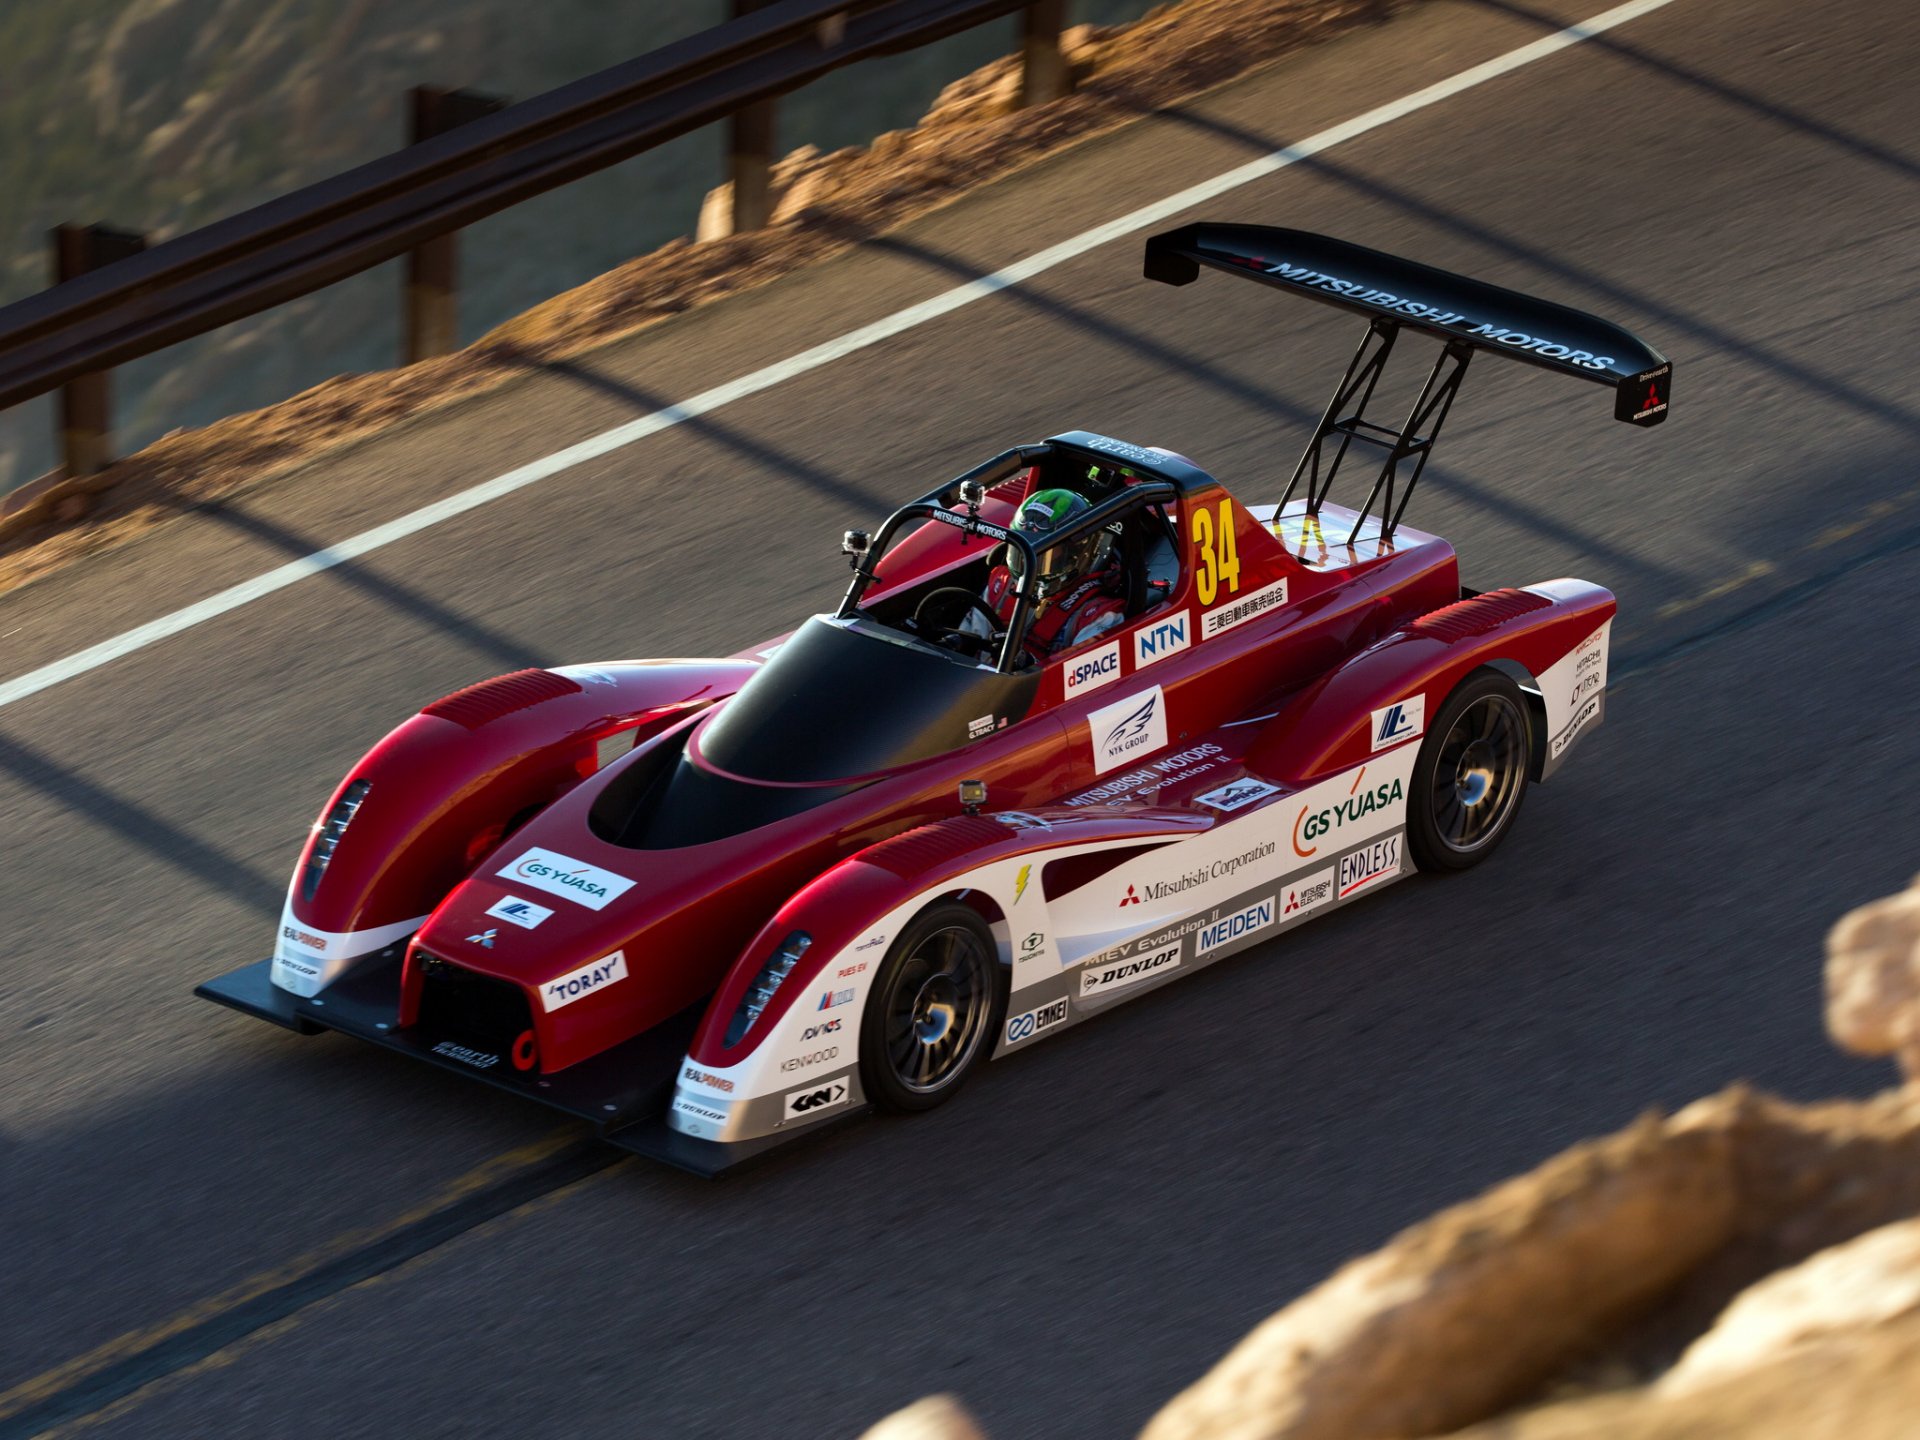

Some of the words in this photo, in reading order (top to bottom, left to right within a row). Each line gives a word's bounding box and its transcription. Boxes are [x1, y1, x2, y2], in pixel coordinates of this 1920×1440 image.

[1265, 262, 1465, 325] MITSUBISHI
[1466, 323, 1616, 370] MOTORS
[976, 523, 1008, 540] MOTORS
[1192, 497, 1240, 606] 34
[1208, 587, 1284, 633] 三菱自動車販売協会
[1141, 618, 1184, 660] NTN
[1067, 652, 1118, 688] dSPACE
[1109, 746, 1124, 757] NYK
[1125, 733, 1150, 752] GROUP
[1064, 769, 1160, 807] MITSUBISHI
[1152, 742, 1223, 773] MOTORS
[1136, 763, 1215, 796] Evolution
[1303, 809, 1331, 841] GS
[1333, 777, 1403, 828] YUASA
[526, 863, 552, 877] GS
[549, 870, 608, 899] YUASA
[1143, 866, 1209, 903] Mitsubishi
[1211, 841, 1275, 880] Corporation
[1341, 836, 1396, 887] ENDLESS
[1137, 918, 1205, 952] Evolution
[1200, 902, 1270, 951] MEIDEN
[1100, 947, 1179, 985] DUNLOP
[1036, 999, 1067, 1030] ENKEI
[780, 1046, 839, 1073] KENWOOD
